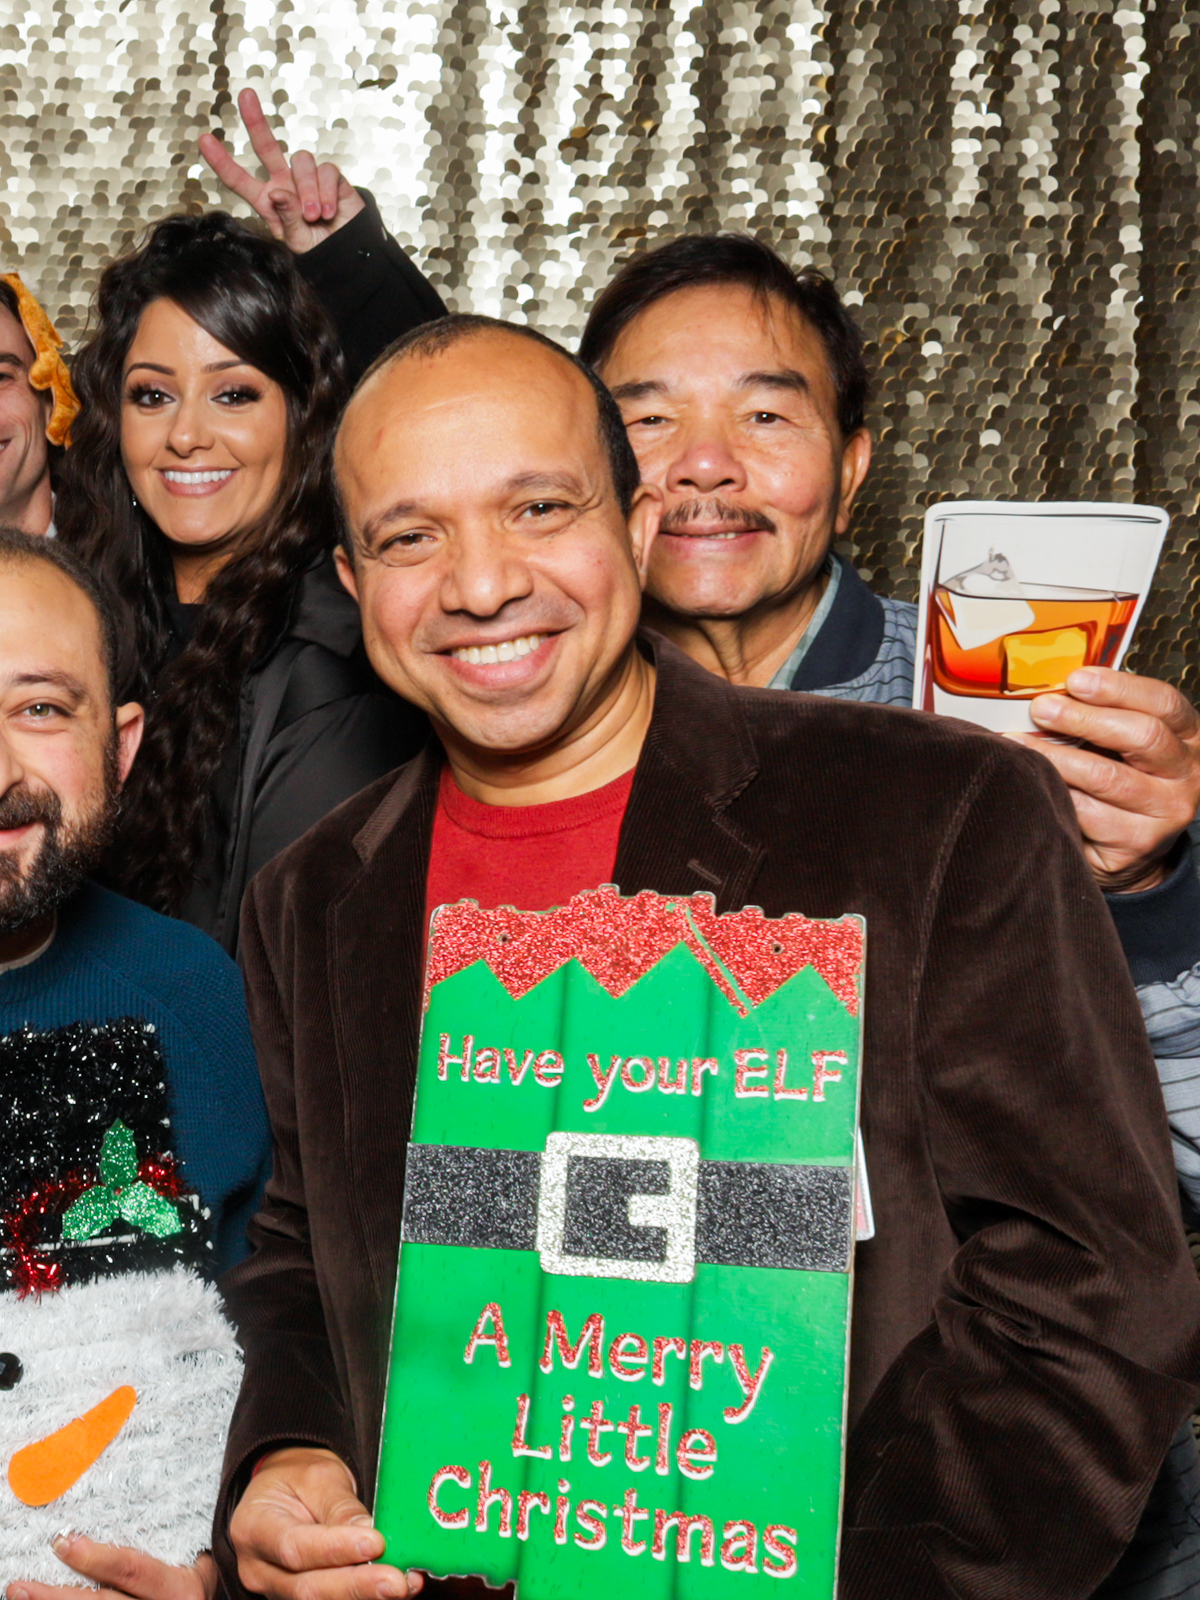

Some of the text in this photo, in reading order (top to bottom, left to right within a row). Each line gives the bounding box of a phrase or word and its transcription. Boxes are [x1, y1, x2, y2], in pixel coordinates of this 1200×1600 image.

[436, 1032, 849, 1113] Have your ELF
[463, 1302, 775, 1424] A Merry
[510, 1393, 718, 1480] Little
[427, 1460, 798, 1579] Christmas
